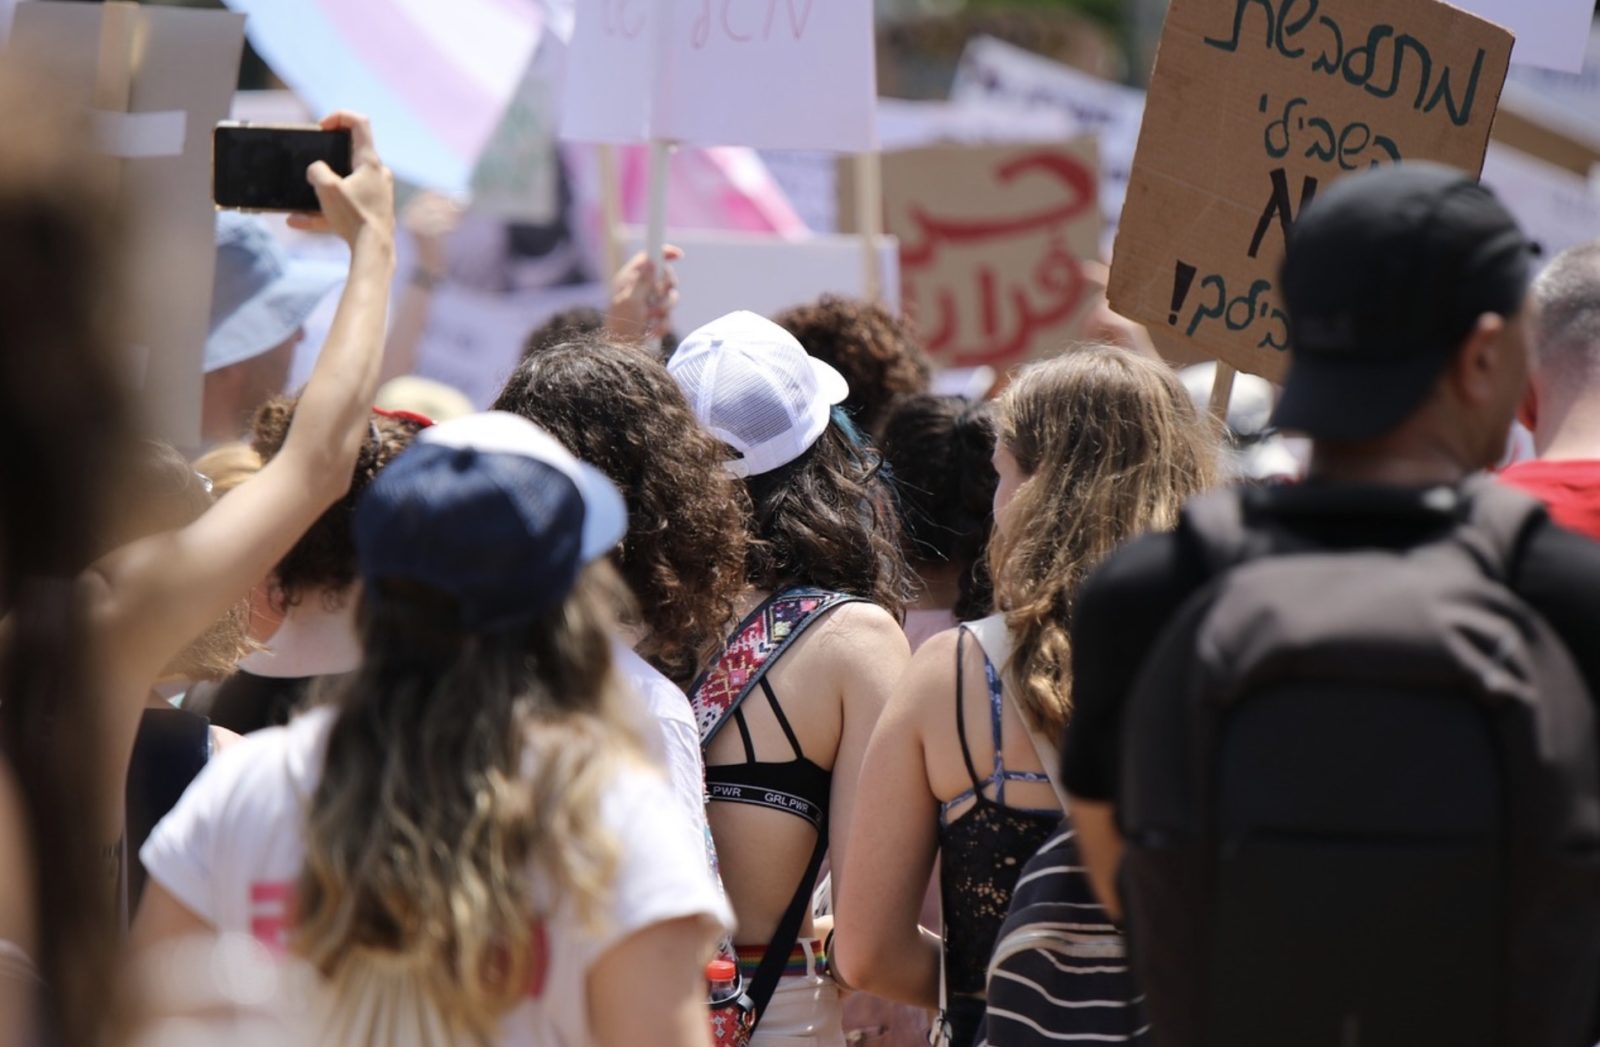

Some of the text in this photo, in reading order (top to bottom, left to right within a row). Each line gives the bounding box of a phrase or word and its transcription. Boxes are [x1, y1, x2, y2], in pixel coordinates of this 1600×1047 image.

[1203, 0, 1486, 126] מתלבשת
[713, 785, 742, 797] PWR
[764, 792, 809, 813] GRL PWR
